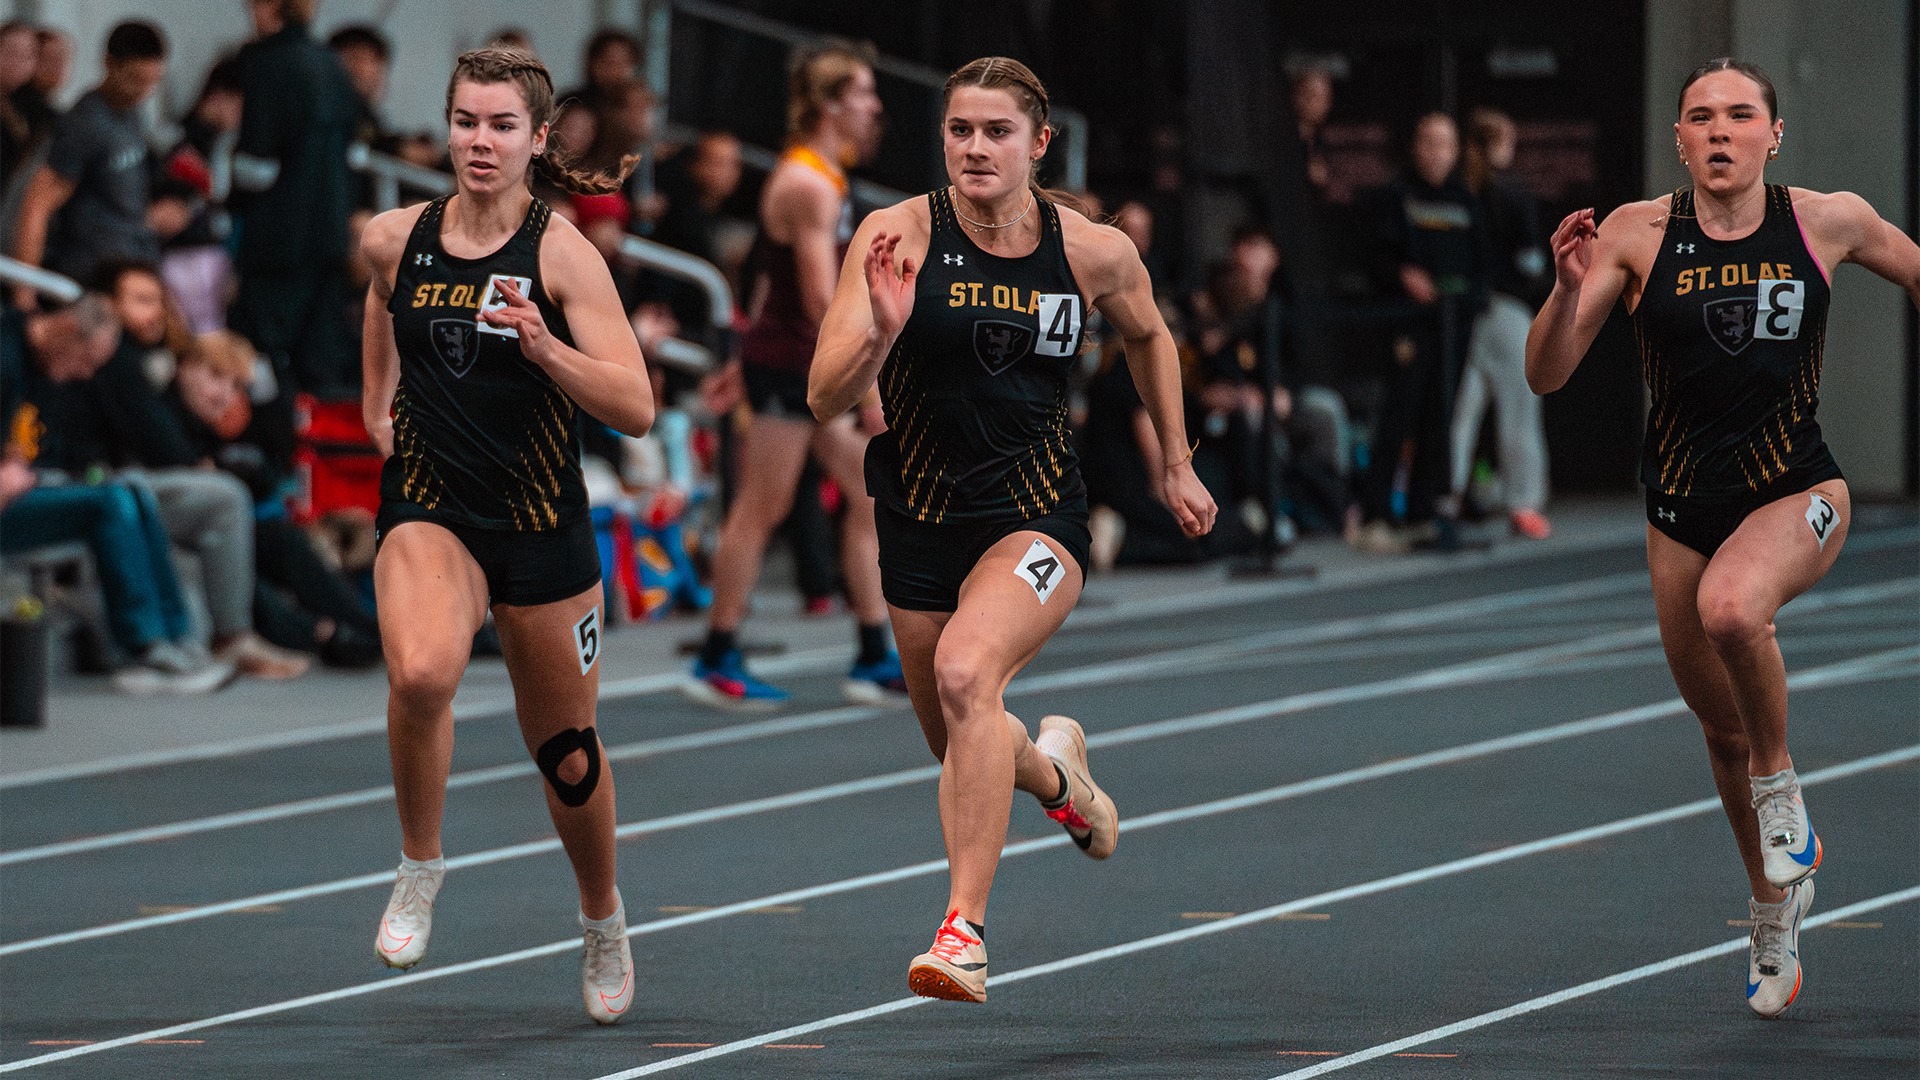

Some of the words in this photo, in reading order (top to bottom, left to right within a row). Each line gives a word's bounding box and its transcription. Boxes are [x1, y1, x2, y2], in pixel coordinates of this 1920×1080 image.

[412, 283, 445, 308] ST.
[450, 284, 488, 309] OL
[949, 282, 987, 307] ST.
[993, 284, 1042, 315] OLA
[1675, 265, 1715, 296] ST.
[1046, 298, 1073, 353] 4
[1766, 282, 1795, 337] 3
[1811, 498, 1834, 540] 3
[1026, 556, 1059, 593] 4
[579, 612, 598, 665] 5
